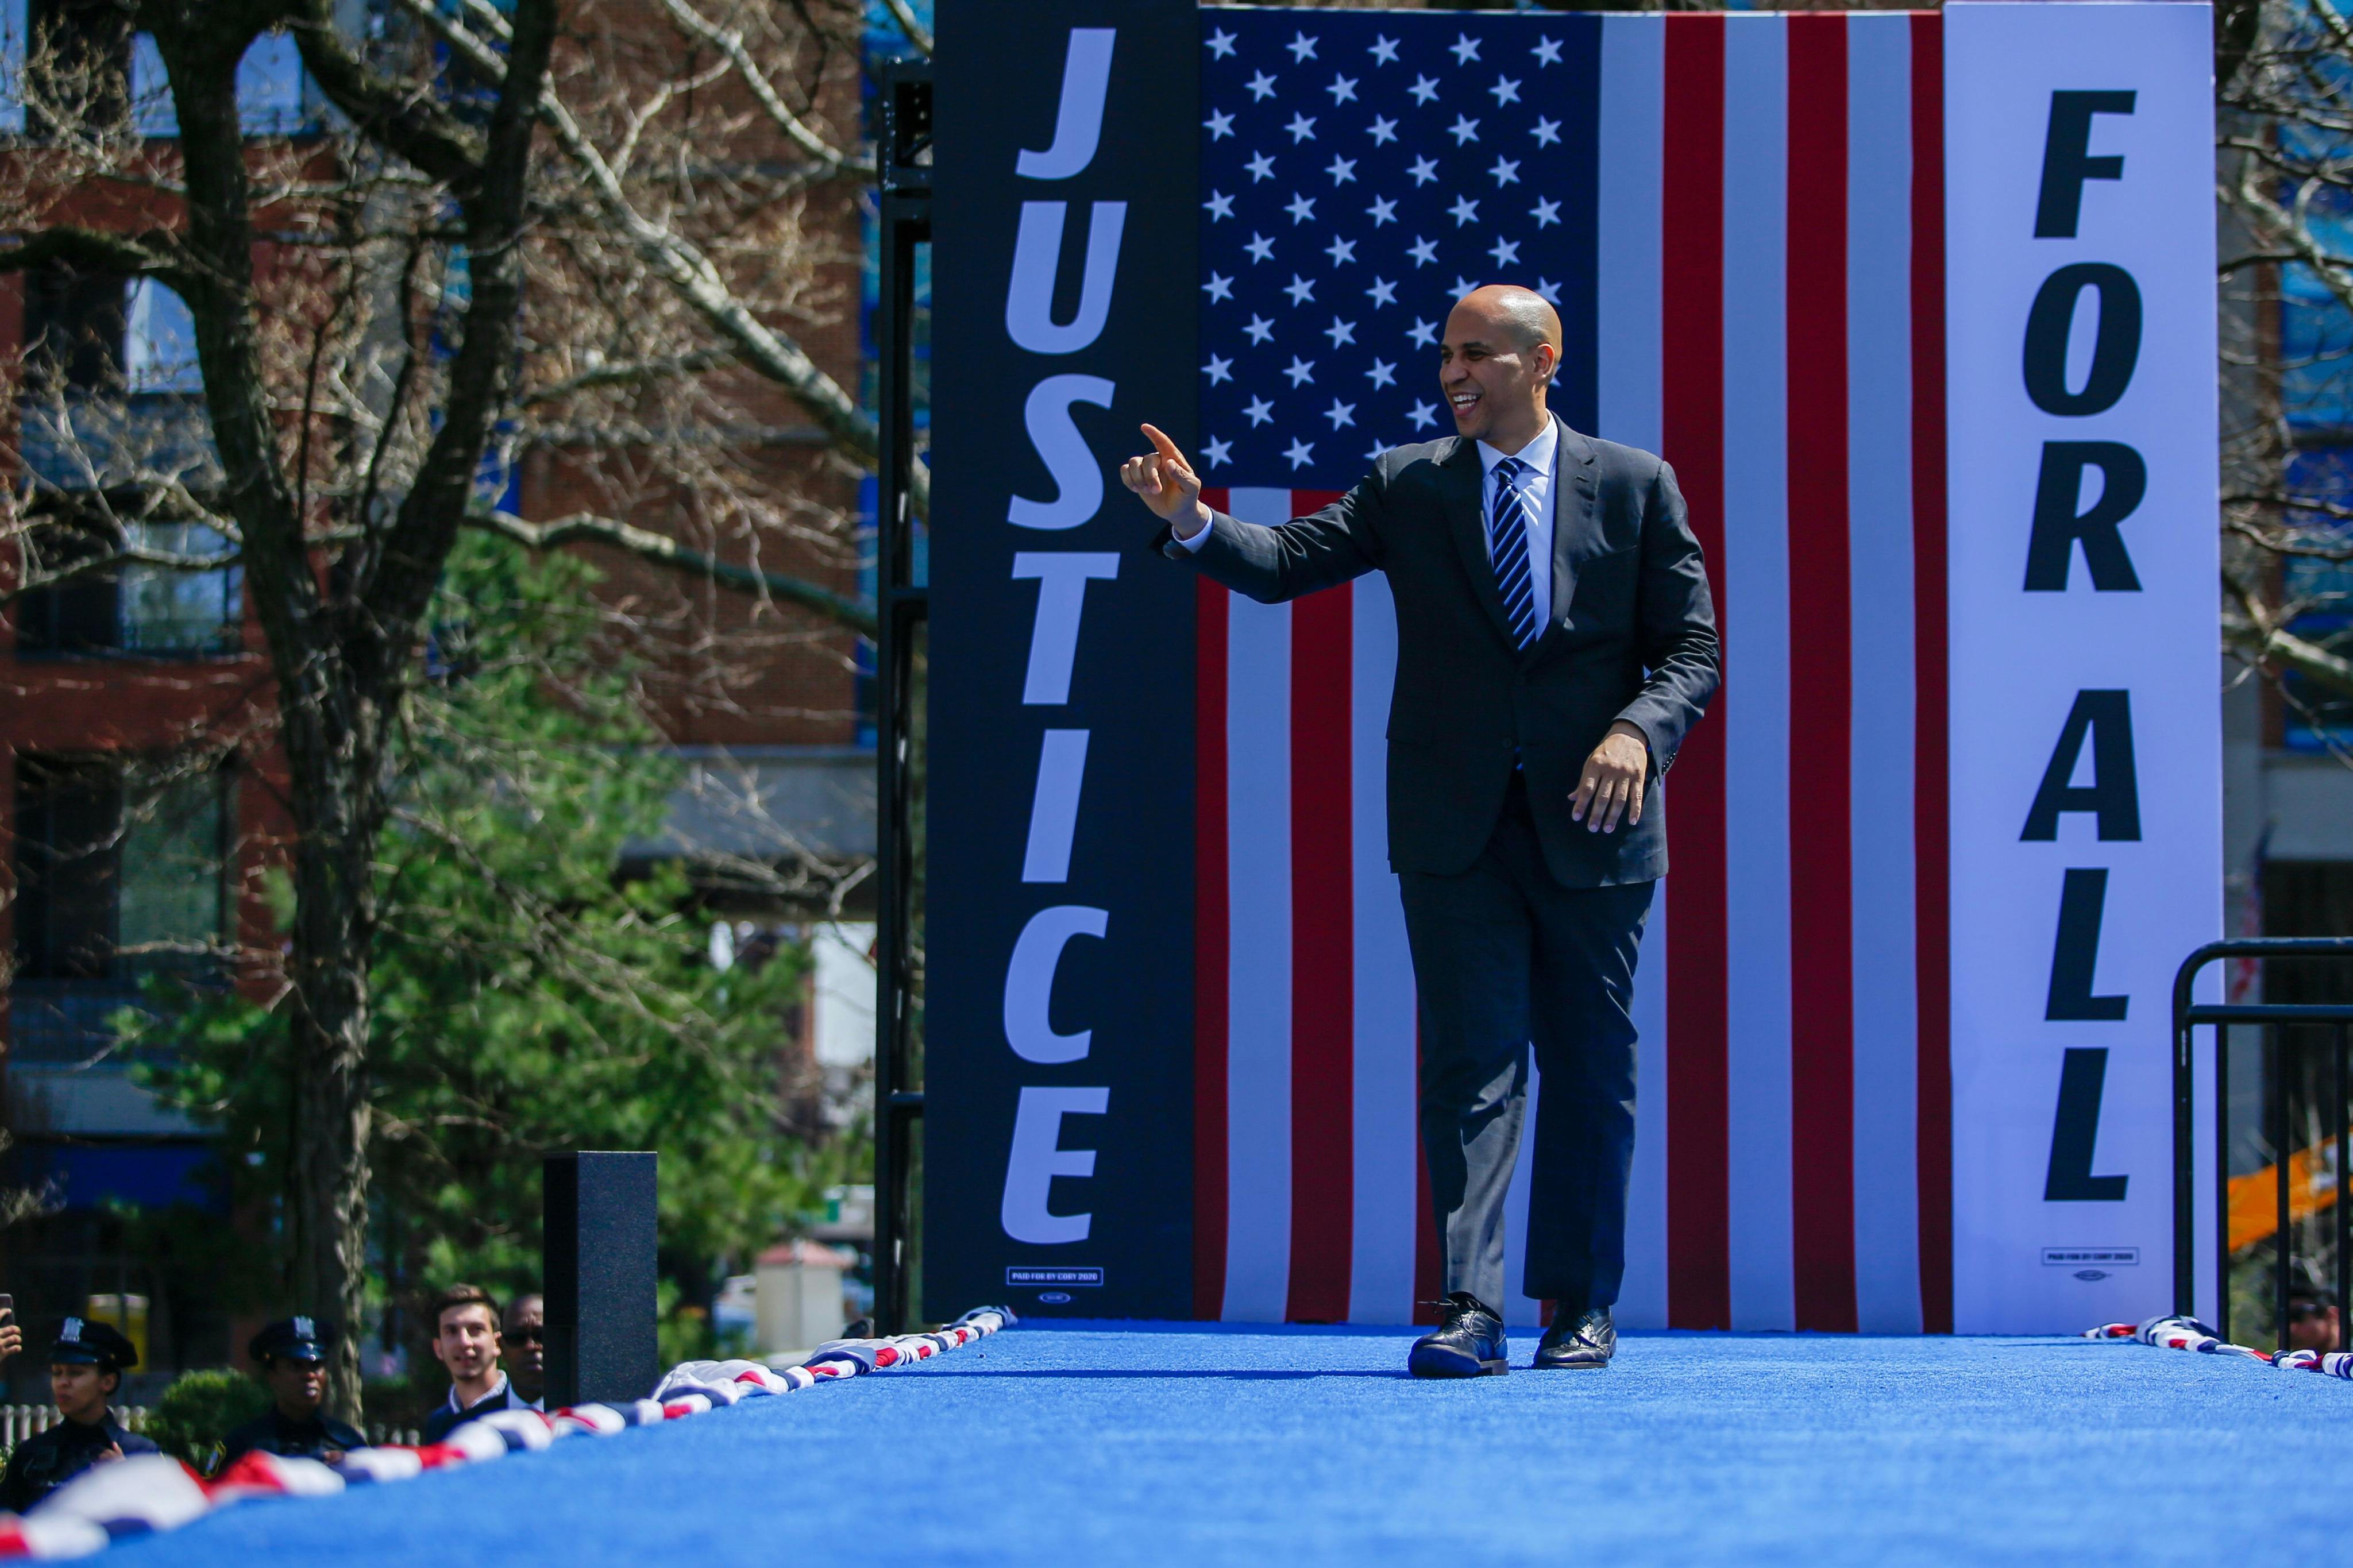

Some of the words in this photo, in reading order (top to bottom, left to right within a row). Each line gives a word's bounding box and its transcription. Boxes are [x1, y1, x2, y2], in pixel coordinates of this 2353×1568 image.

[2022, 89, 2148, 592] FOR
[1002, 28, 1127, 1244] JUSTICE
[2018, 689, 2142, 1202] ALL
[1012, 1272, 1030, 1281] PAID
[1031, 1272, 1045, 1281] FOR
[1046, 1272, 1056, 1281] BY
[1057, 1272, 1077, 1281] CORY
[1078, 1272, 1097, 1281] 2020
